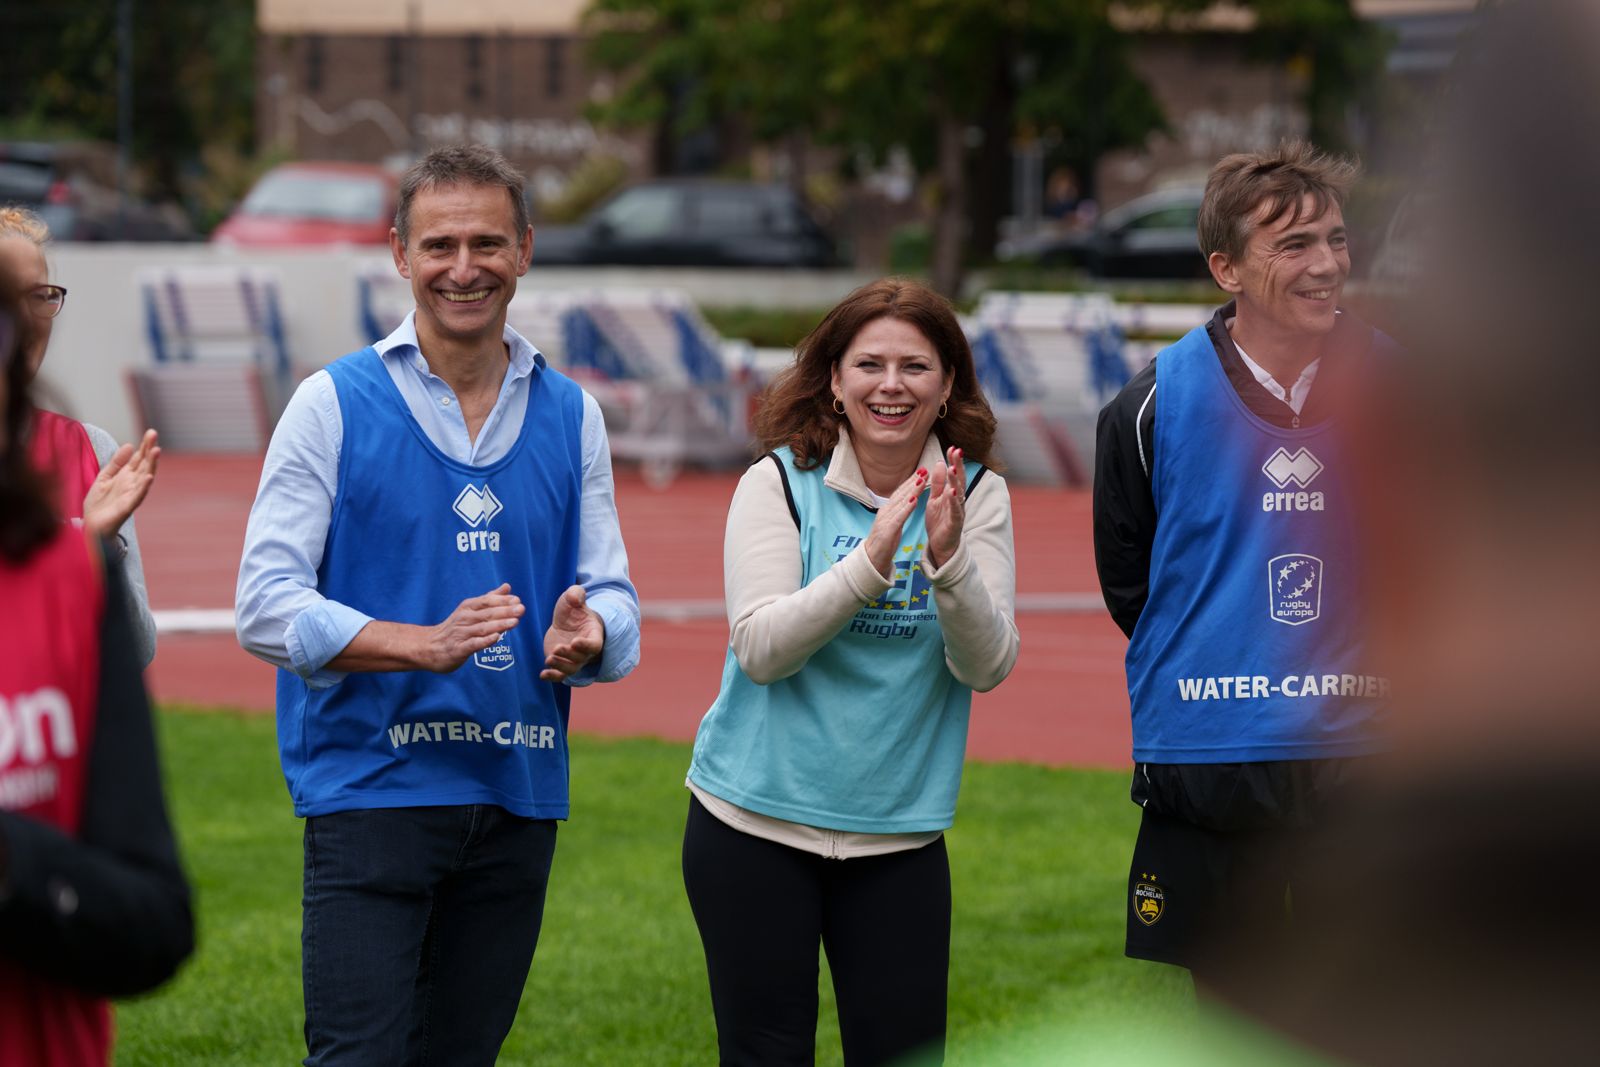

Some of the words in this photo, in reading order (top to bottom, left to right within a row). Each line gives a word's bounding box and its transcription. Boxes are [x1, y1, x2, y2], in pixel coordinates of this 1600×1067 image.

[1262, 491, 1325, 512] errea
[1280, 600, 1311, 610] rugby
[883, 612, 937, 623] Européen
[1276, 610, 1314, 618] europe
[849, 619, 918, 640] Rugby
[1177, 673, 1393, 701] WATER-CARRIER
